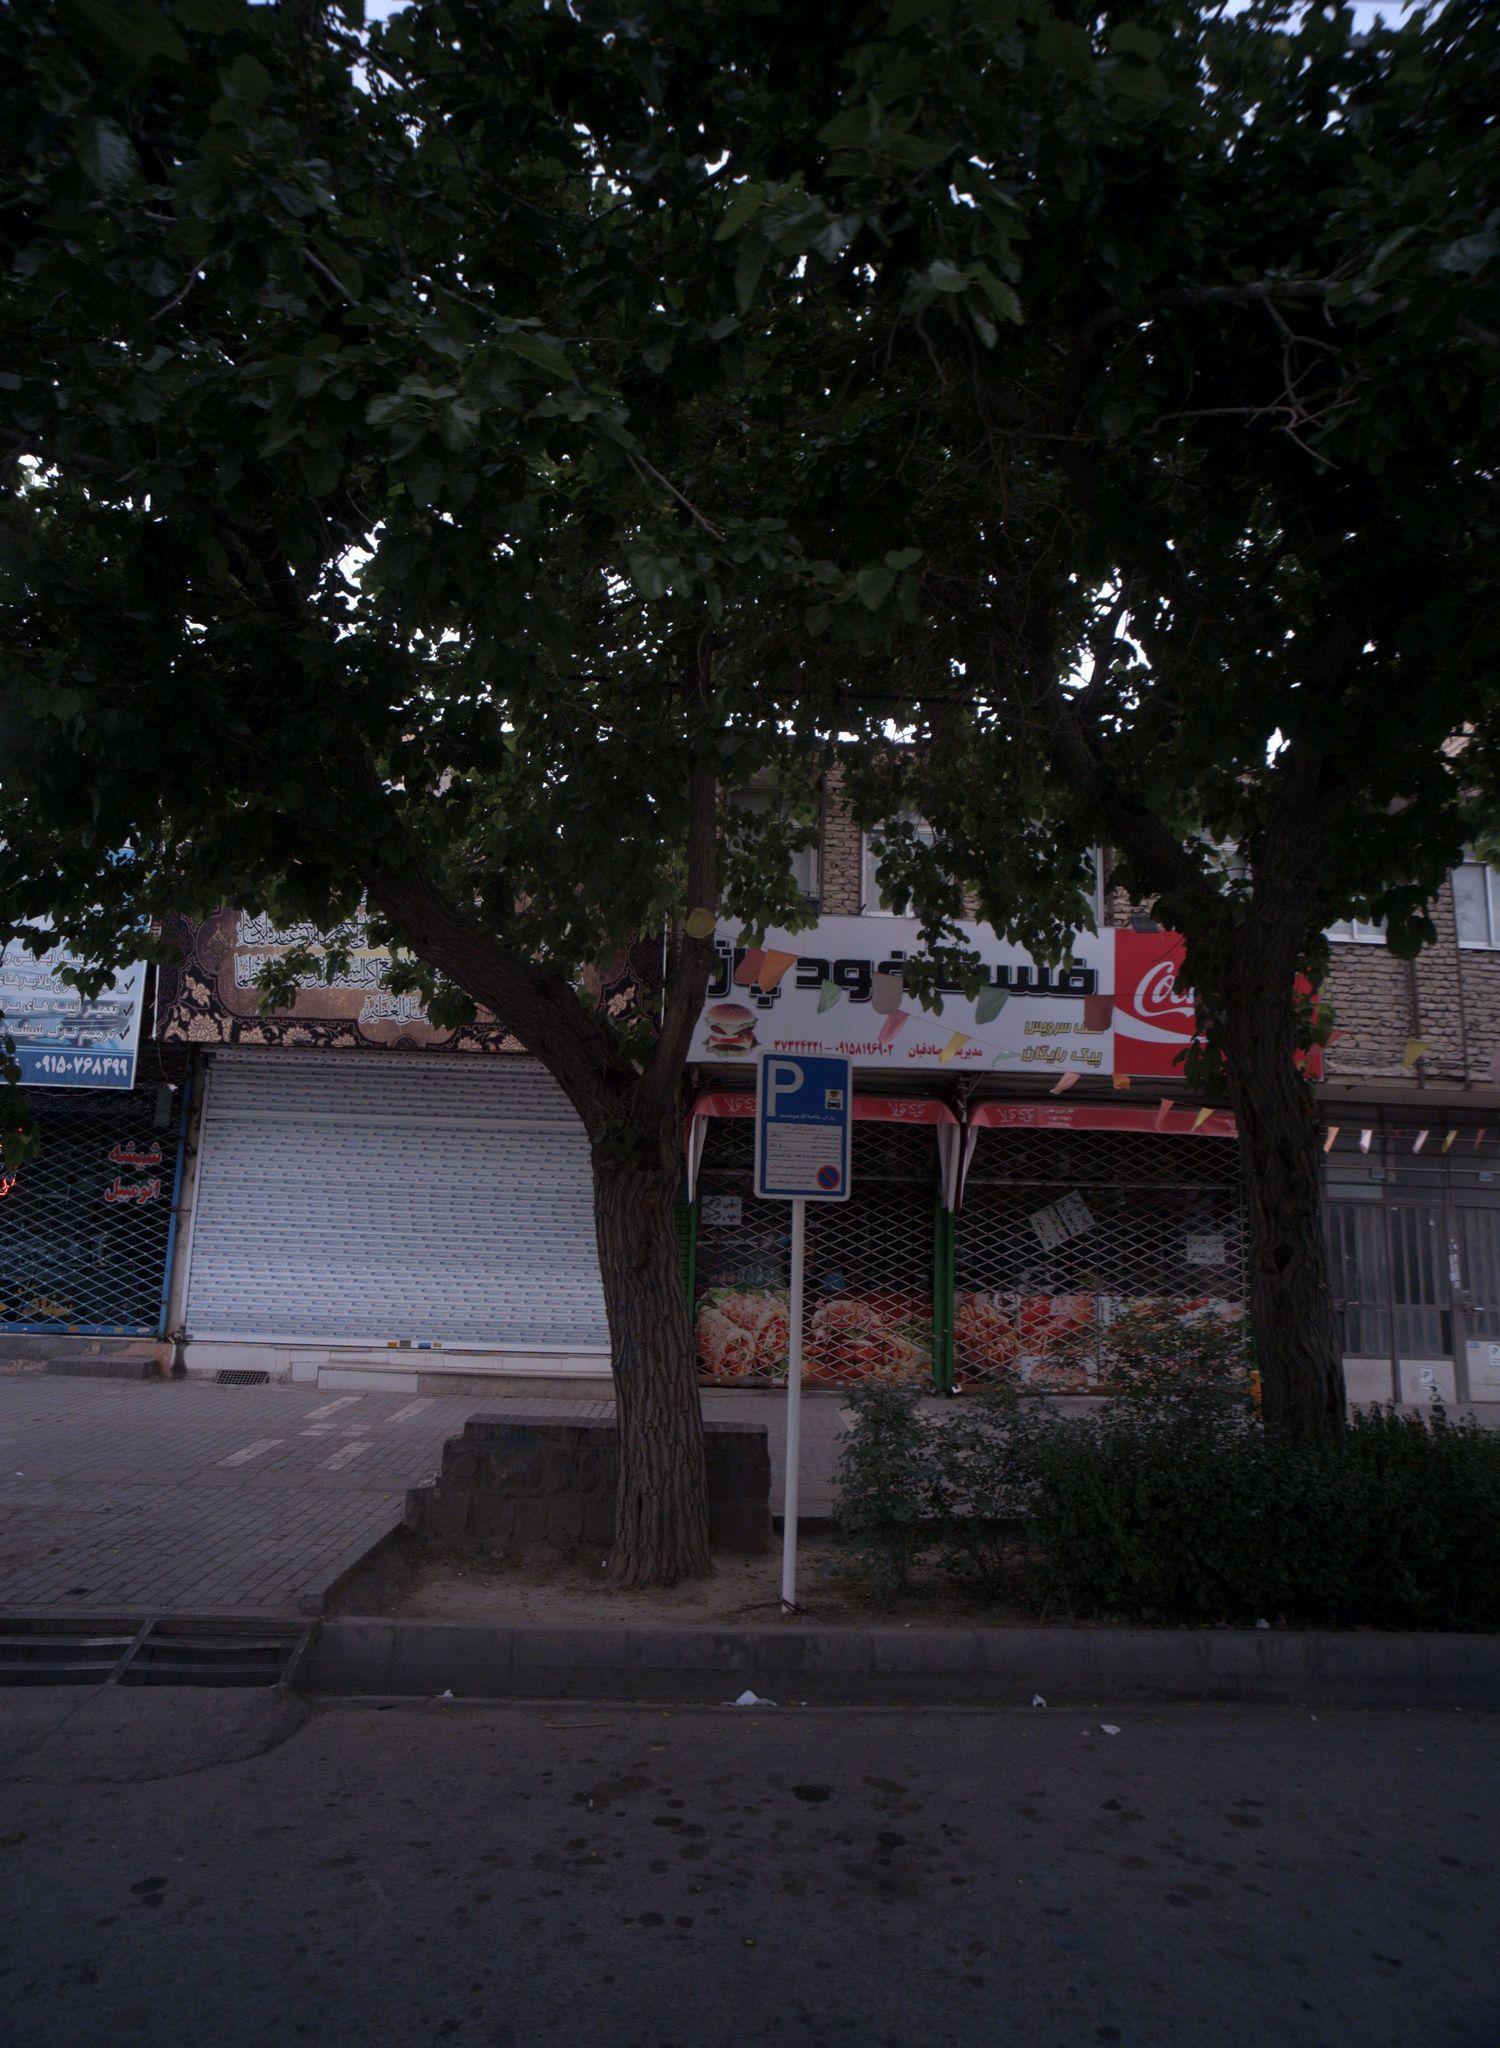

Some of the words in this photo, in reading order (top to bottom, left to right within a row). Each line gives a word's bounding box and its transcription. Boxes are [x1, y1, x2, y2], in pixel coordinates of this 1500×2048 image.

[23, 1001, 49, 1014] های
[83, 1002, 119, 1018] تعمیر
[8, 1022, 44, 1041] شیشه
[48, 1023, 79, 1042] ترک
[79, 1027, 117, 1048] ترمیم
[1024, 1020, 1072, 1037] سرویس
[1021, 1044, 1067, 1064] رایگان
[1070, 1046, 1104, 1068] پیک
[35, 1055, 128, 1077] ۰۹۱۵۰۷۶۸۴۹۹
[767, 1059, 804, 1117] P
